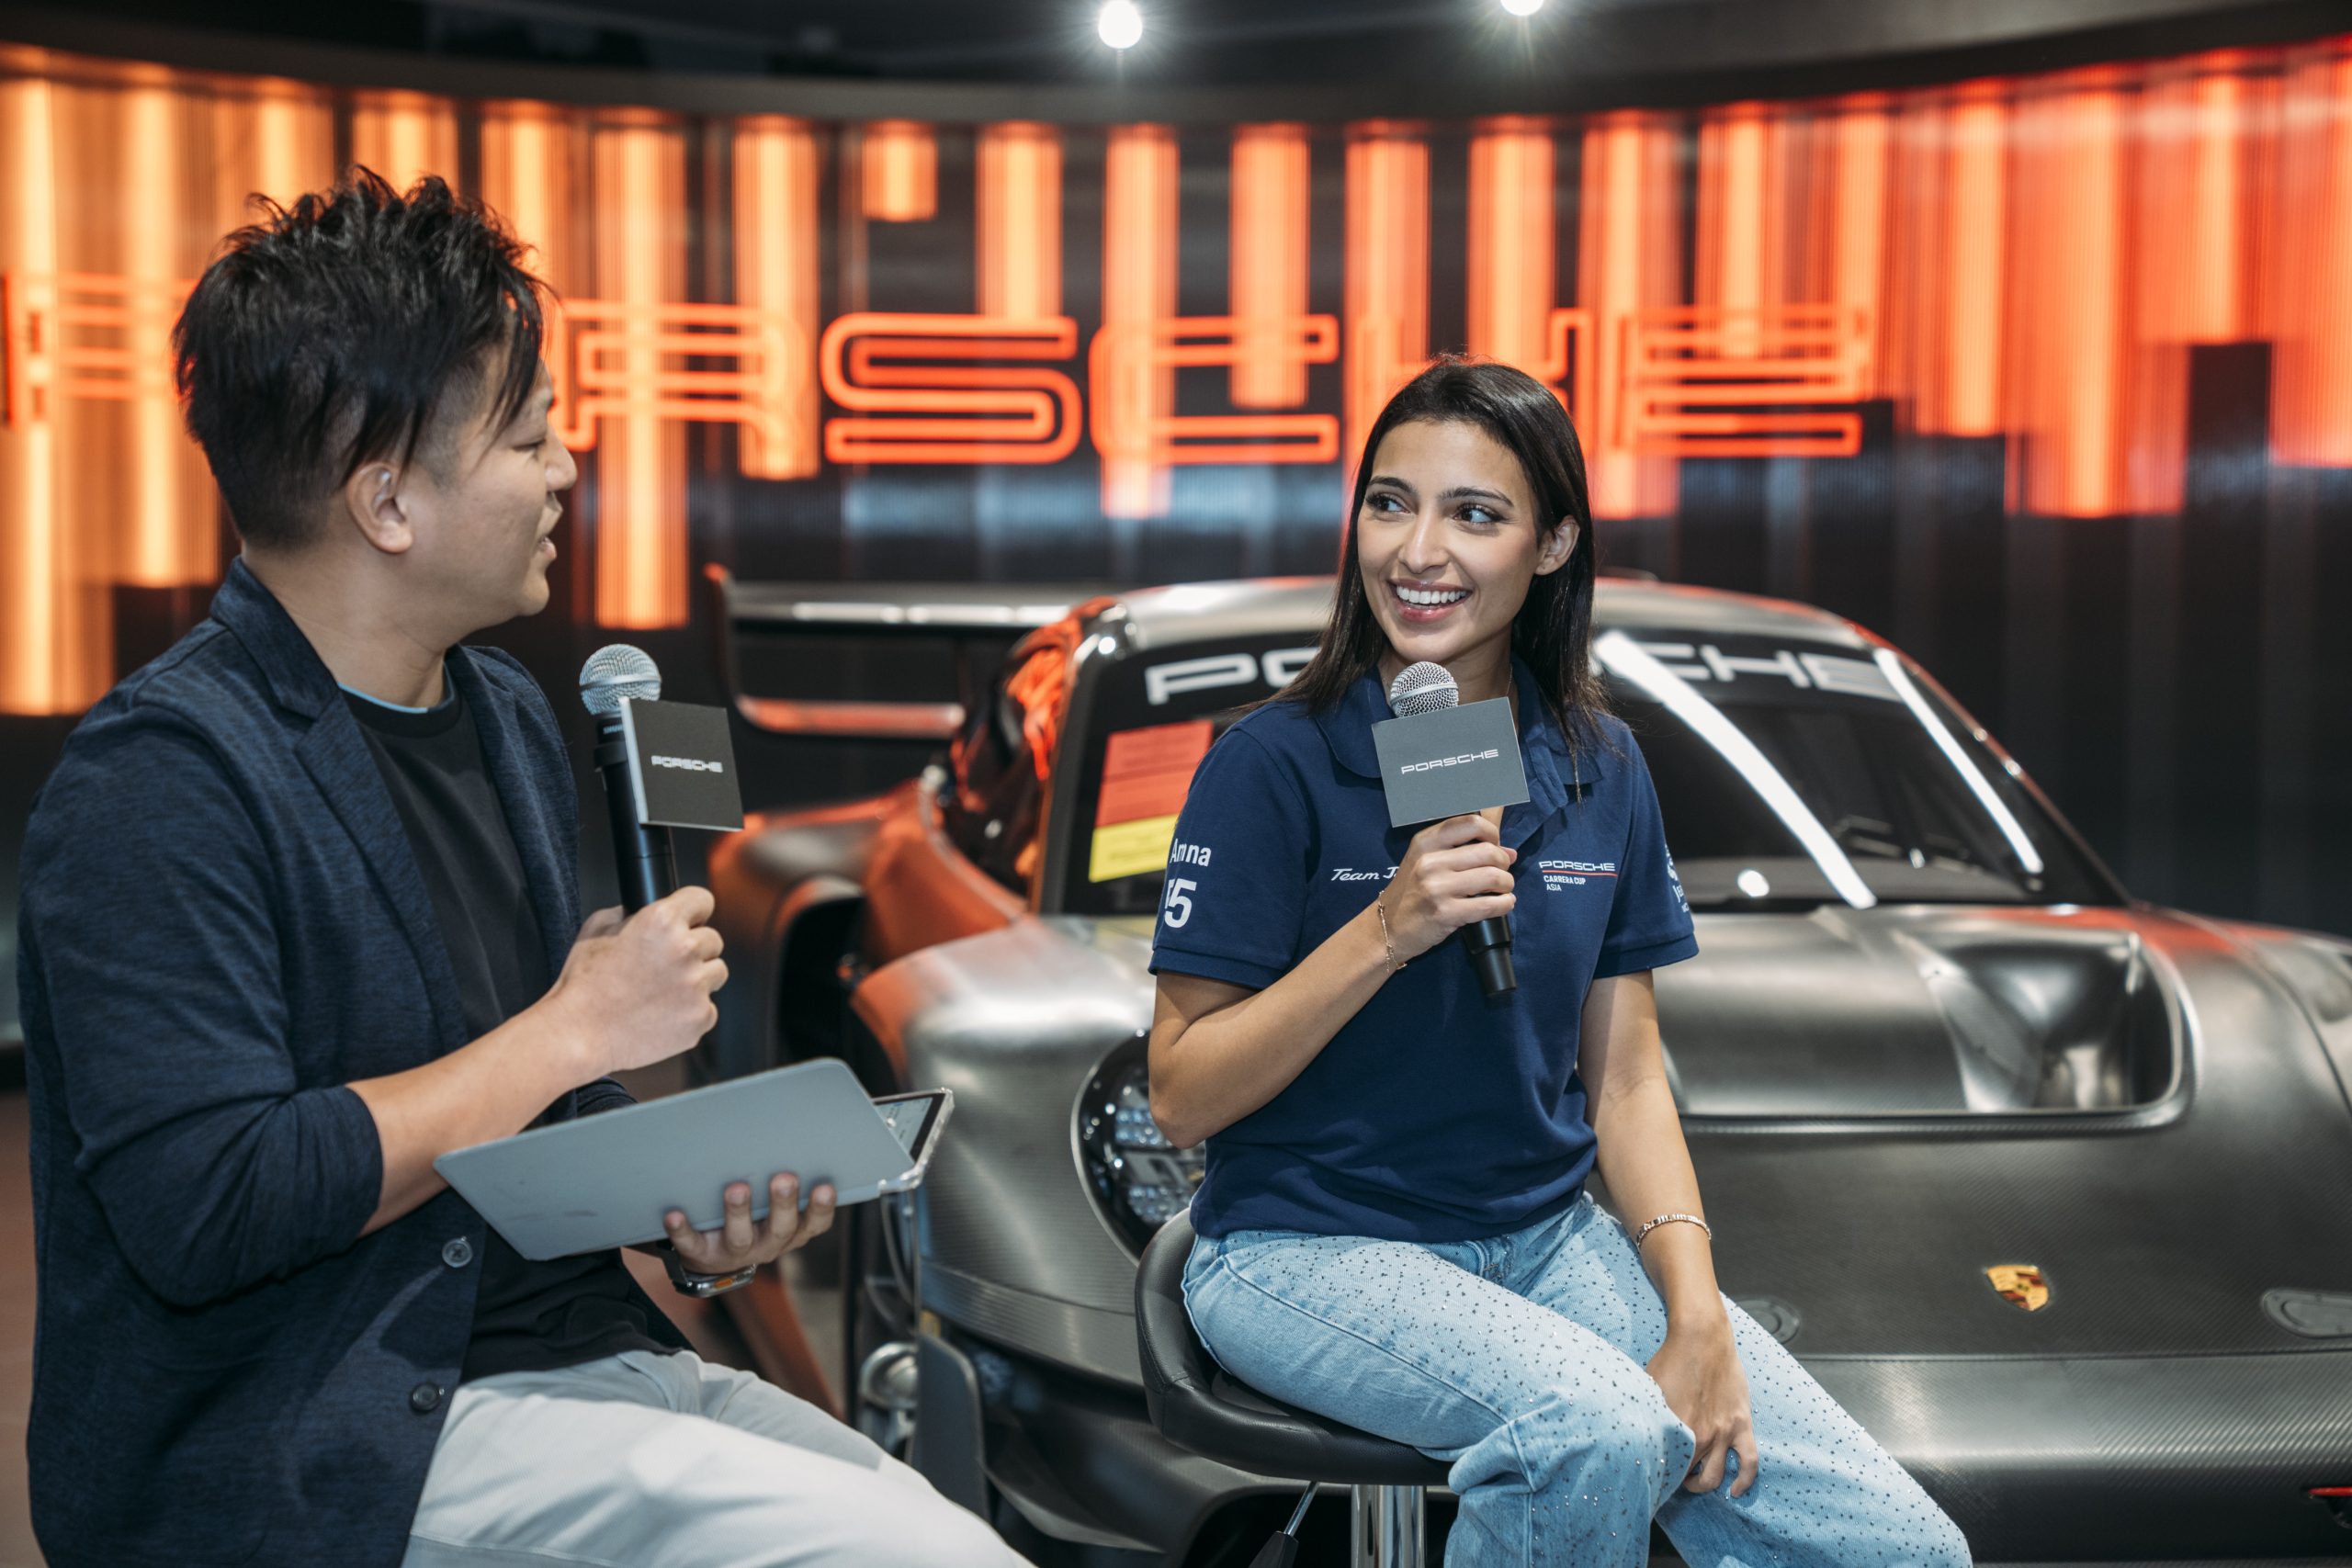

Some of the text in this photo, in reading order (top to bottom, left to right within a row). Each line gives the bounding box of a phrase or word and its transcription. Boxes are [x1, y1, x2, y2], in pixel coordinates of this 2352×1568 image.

[650, 755, 723, 773] PORSCHE
[1400, 749, 1499, 774] PORSCHE
[1170, 838, 1212, 867] Anna
[1539, 860, 1616, 872] PORSCHE
[1330, 867, 1380, 881] Team
[1544, 874, 1586, 886] CARRERA CUP
[1546, 883, 1562, 892] ASIA
